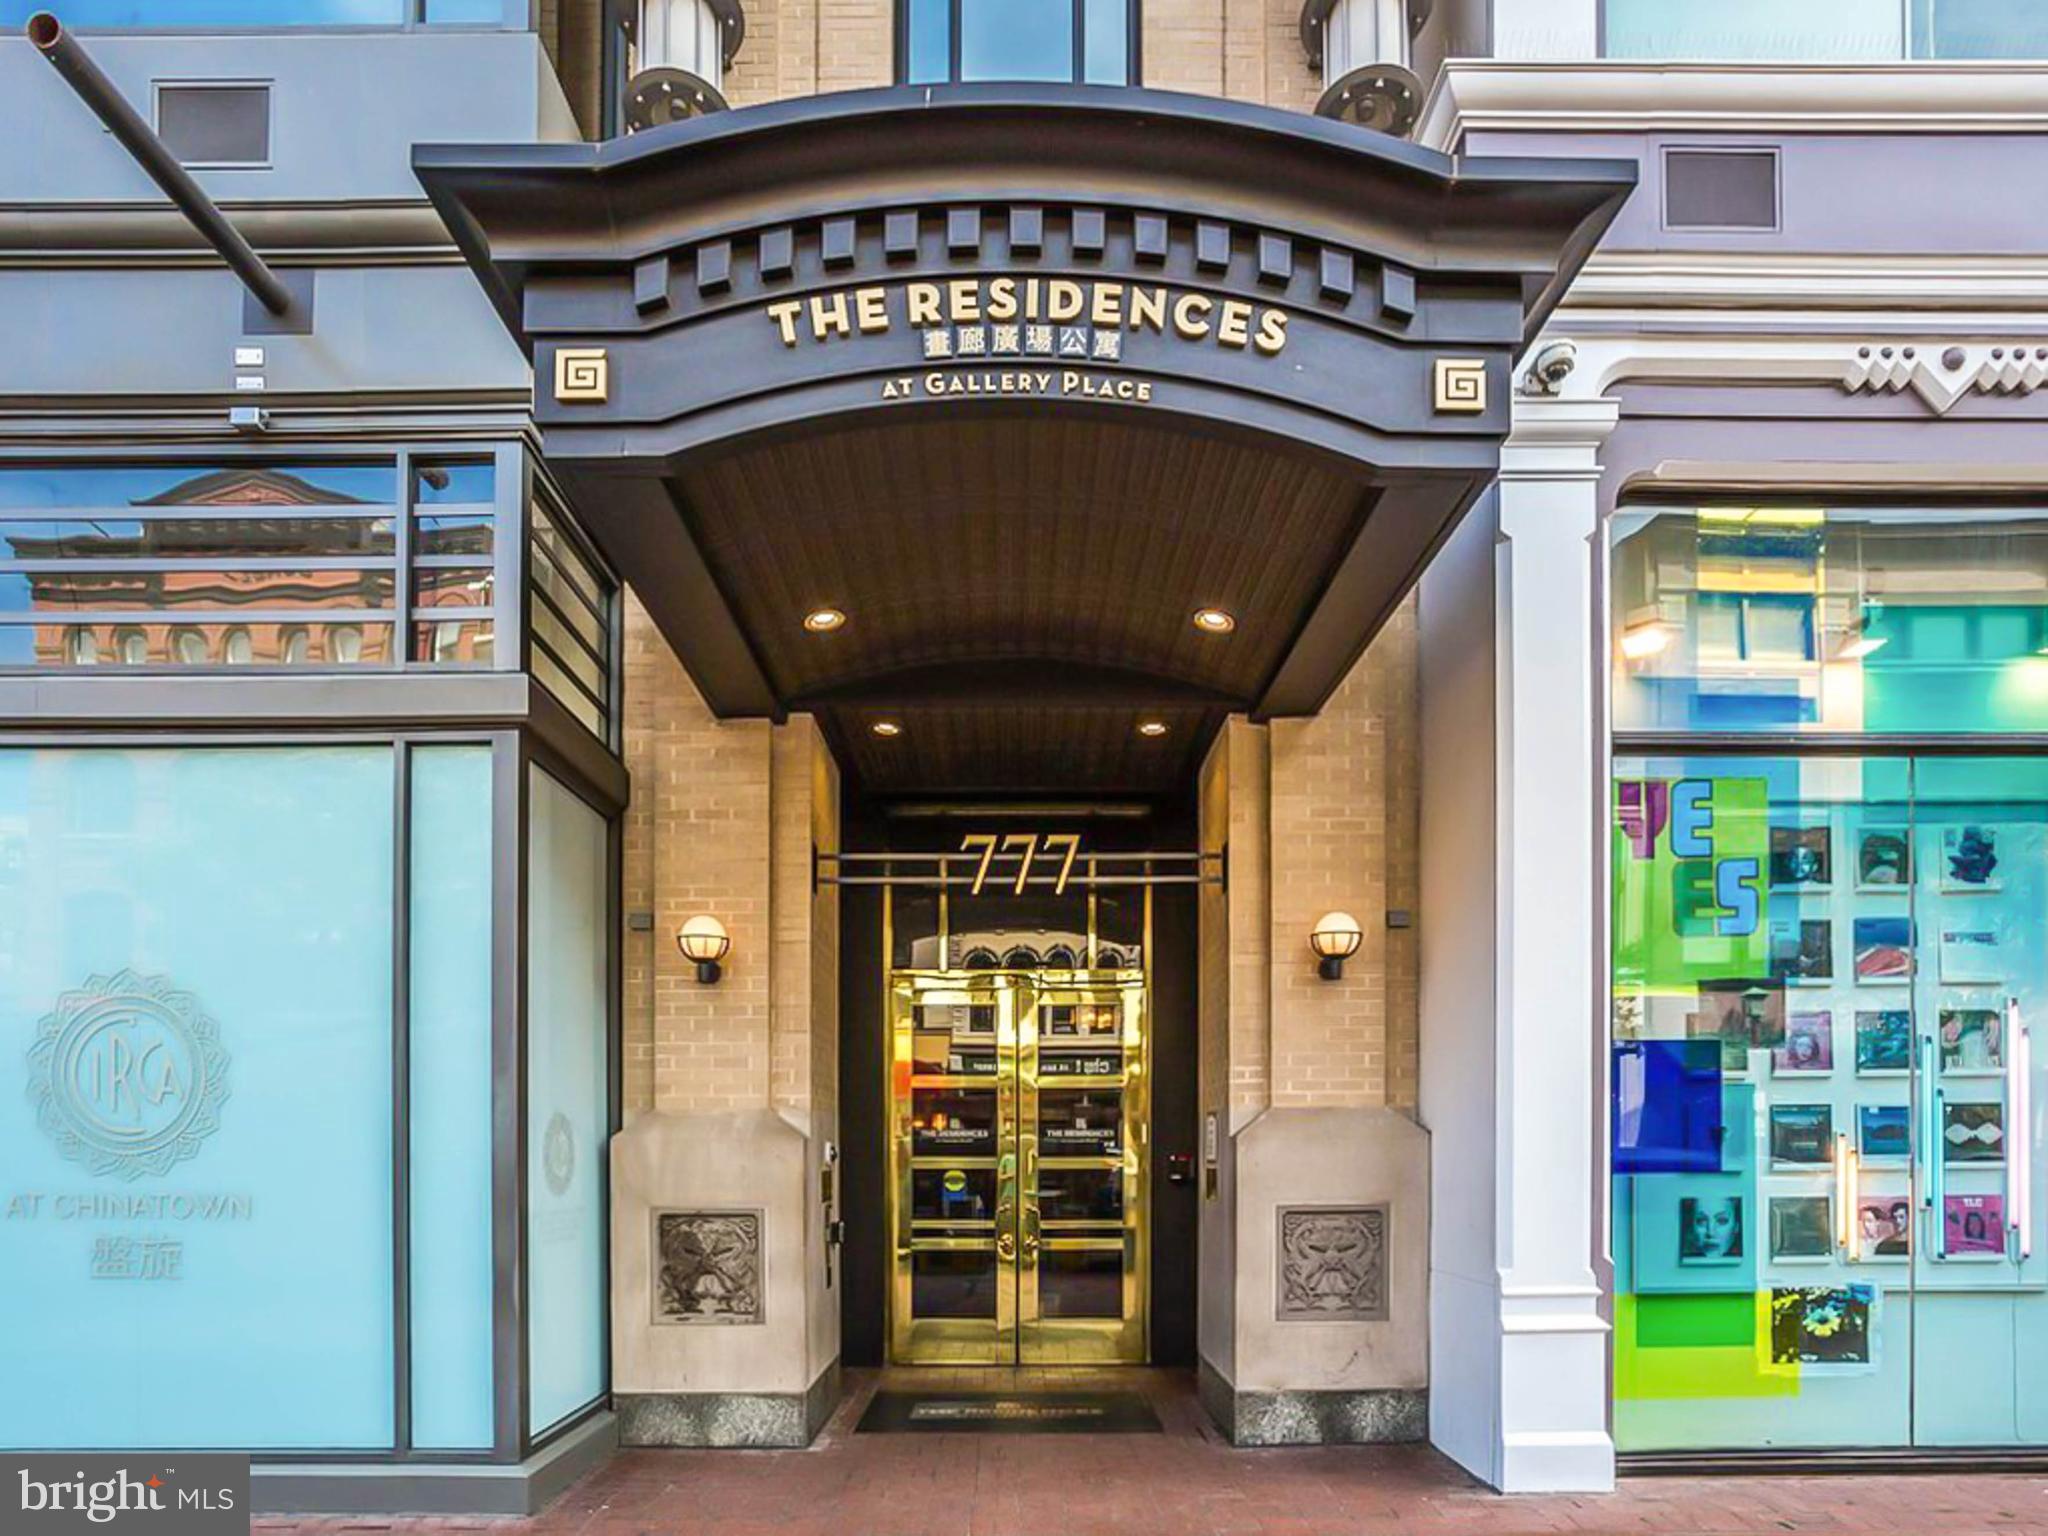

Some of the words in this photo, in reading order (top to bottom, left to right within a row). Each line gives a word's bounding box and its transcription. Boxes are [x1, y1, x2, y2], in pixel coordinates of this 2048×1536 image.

[767, 286, 890, 347] THE
[907, 278, 1288, 355] RESIDENCES
[882, 378, 913, 399] AT
[925, 372, 1051, 394] GALLERY
[1063, 371, 1152, 401] PLACE
[960, 834, 1080, 895] 777
[7, 1194, 44, 1220] AT
[55, 1194, 254, 1221] CHINATOWN
